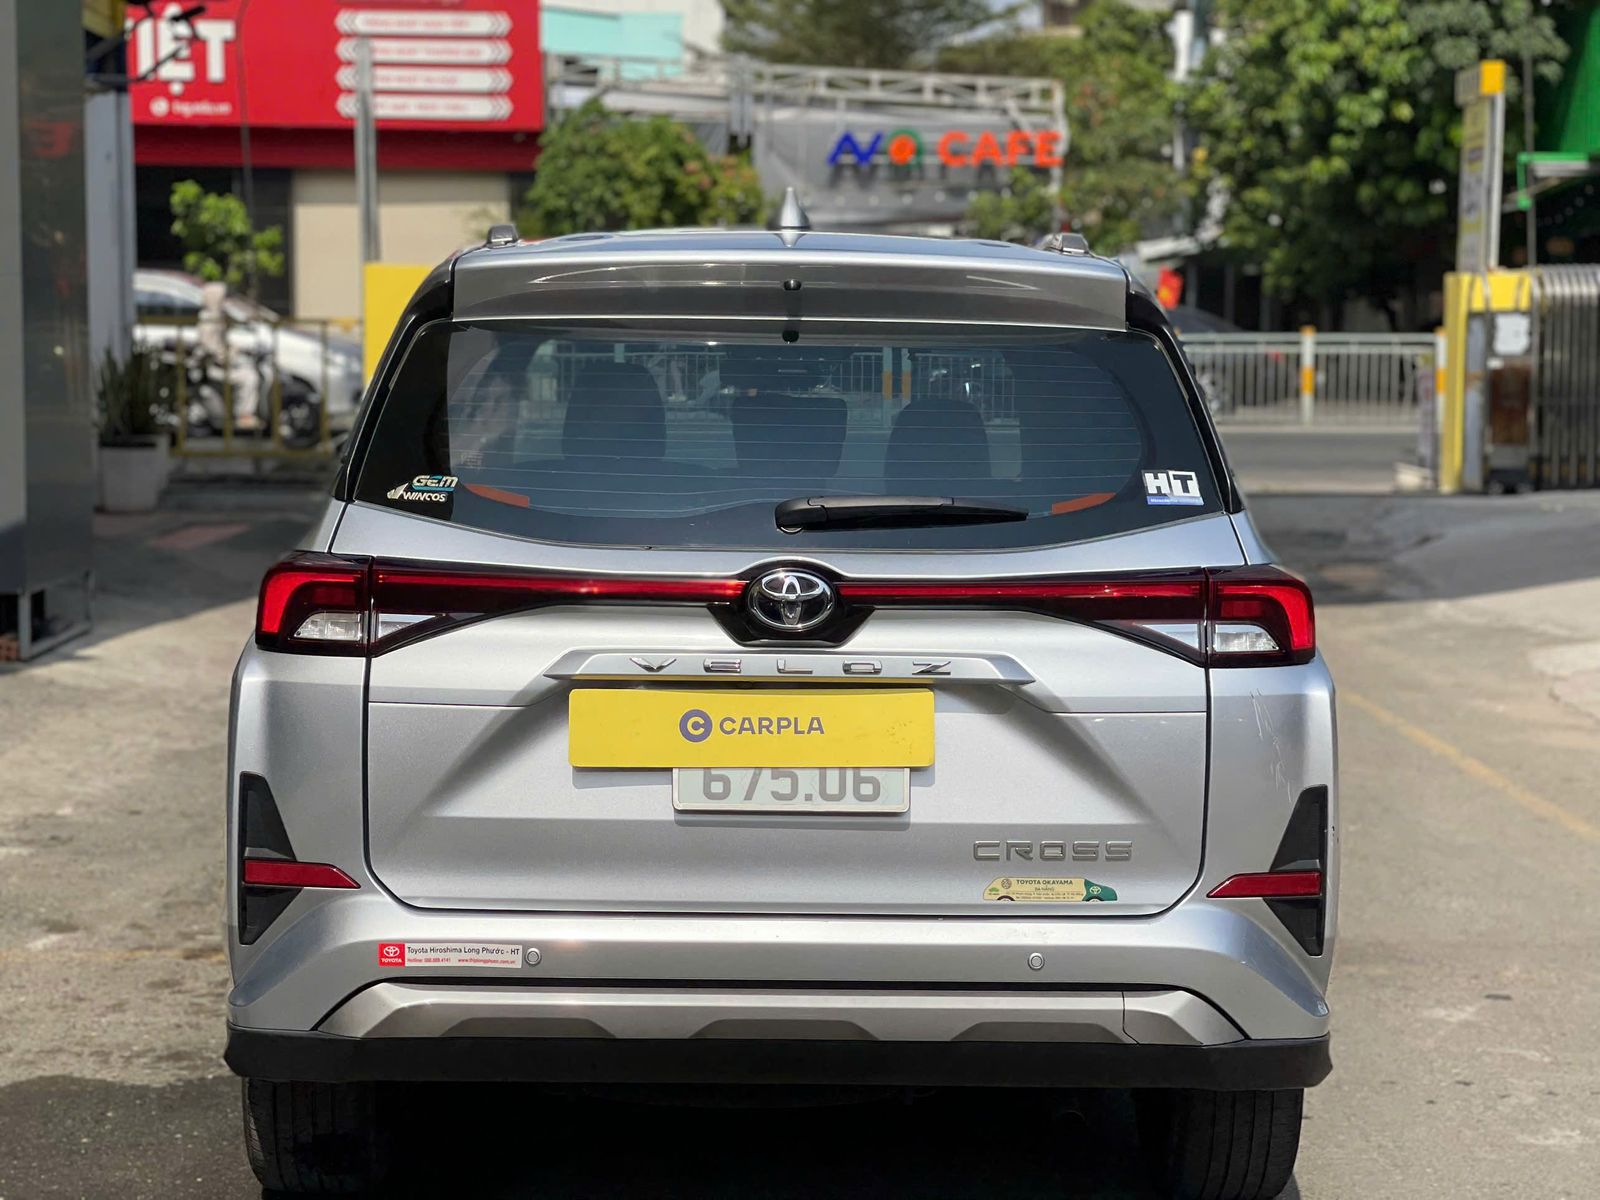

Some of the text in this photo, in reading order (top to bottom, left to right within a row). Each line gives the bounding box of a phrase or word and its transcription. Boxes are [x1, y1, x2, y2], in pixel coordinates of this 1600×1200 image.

[936, 130, 1064, 168] CAFE
[1144, 472, 1196, 496] HT
[403, 491, 447, 502] WINCOS
[629, 657, 952, 675] VELOZ
[718, 716, 825, 735] CARPLA
[973, 840, 1133, 861] CROSS
[407, 946, 429, 955] Toyota
[430, 946, 462, 954] Hiroshima
[463, 947, 480, 955] Long
